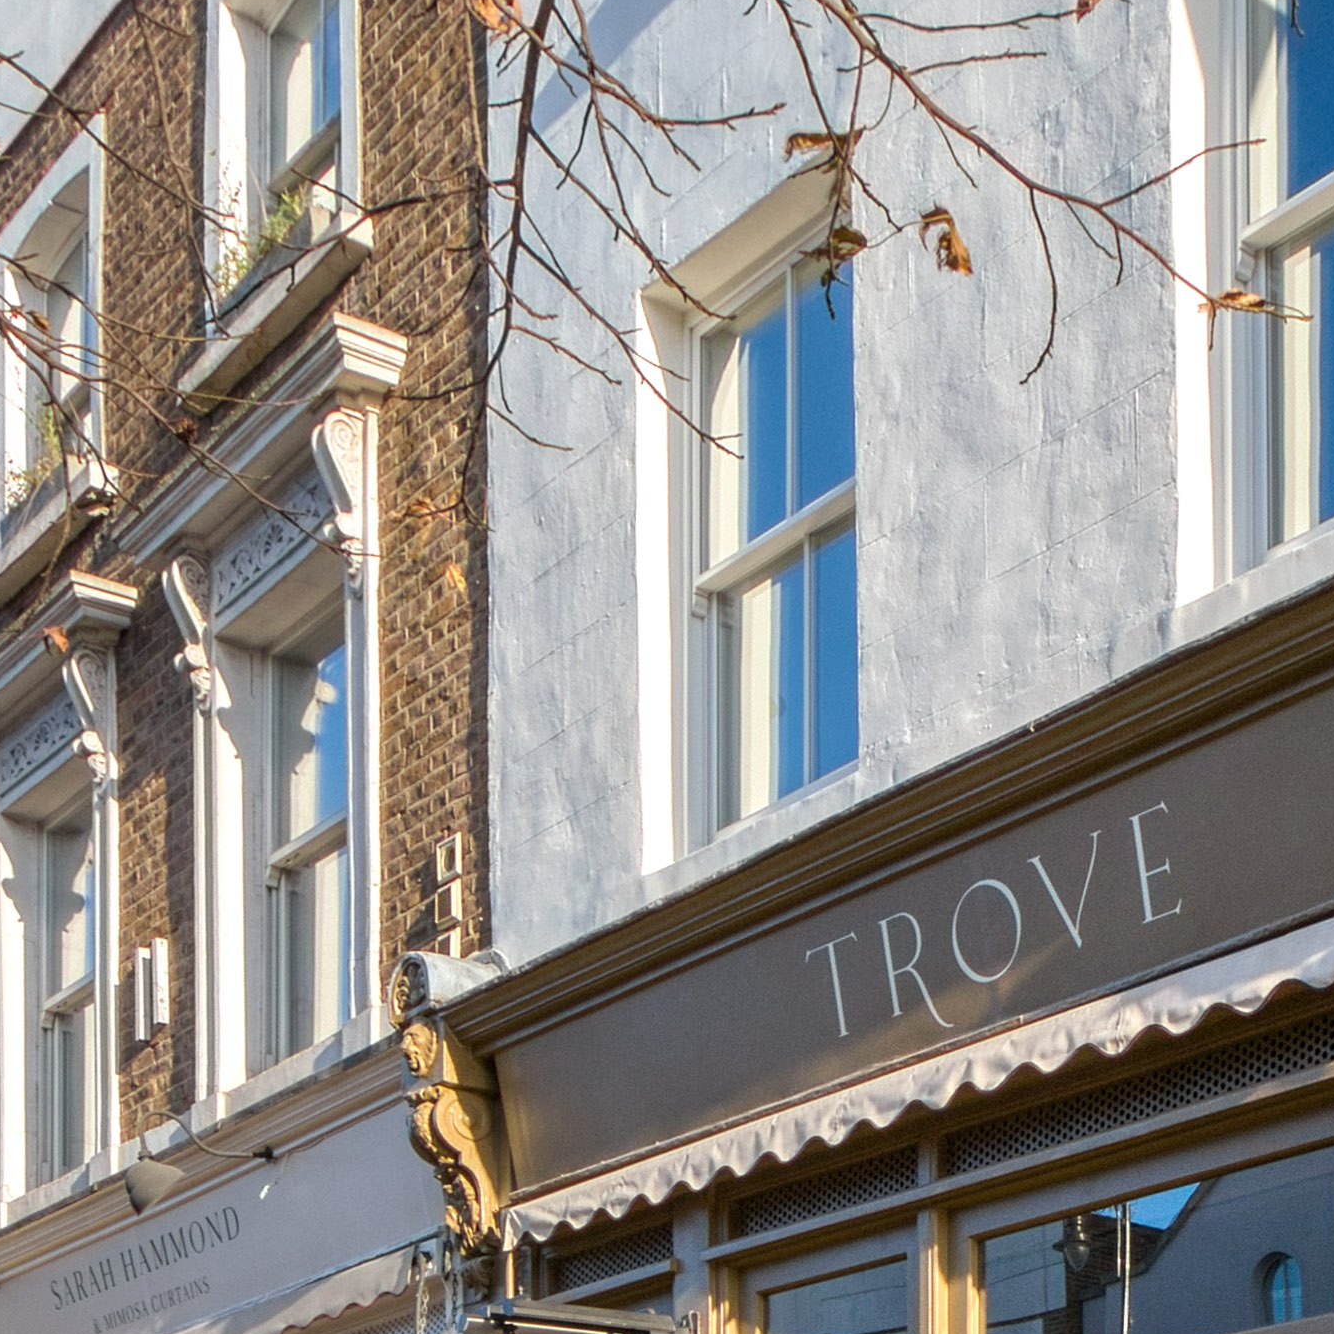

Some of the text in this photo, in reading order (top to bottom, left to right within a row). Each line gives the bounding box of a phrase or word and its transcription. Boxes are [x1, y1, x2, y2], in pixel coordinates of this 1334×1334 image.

[804, 800, 1183, 1038] TROVE
[50, 1205, 241, 1311] SARAH HAMMOND
[93, 1275, 211, 1334] & MIMOSA CURTAINS
